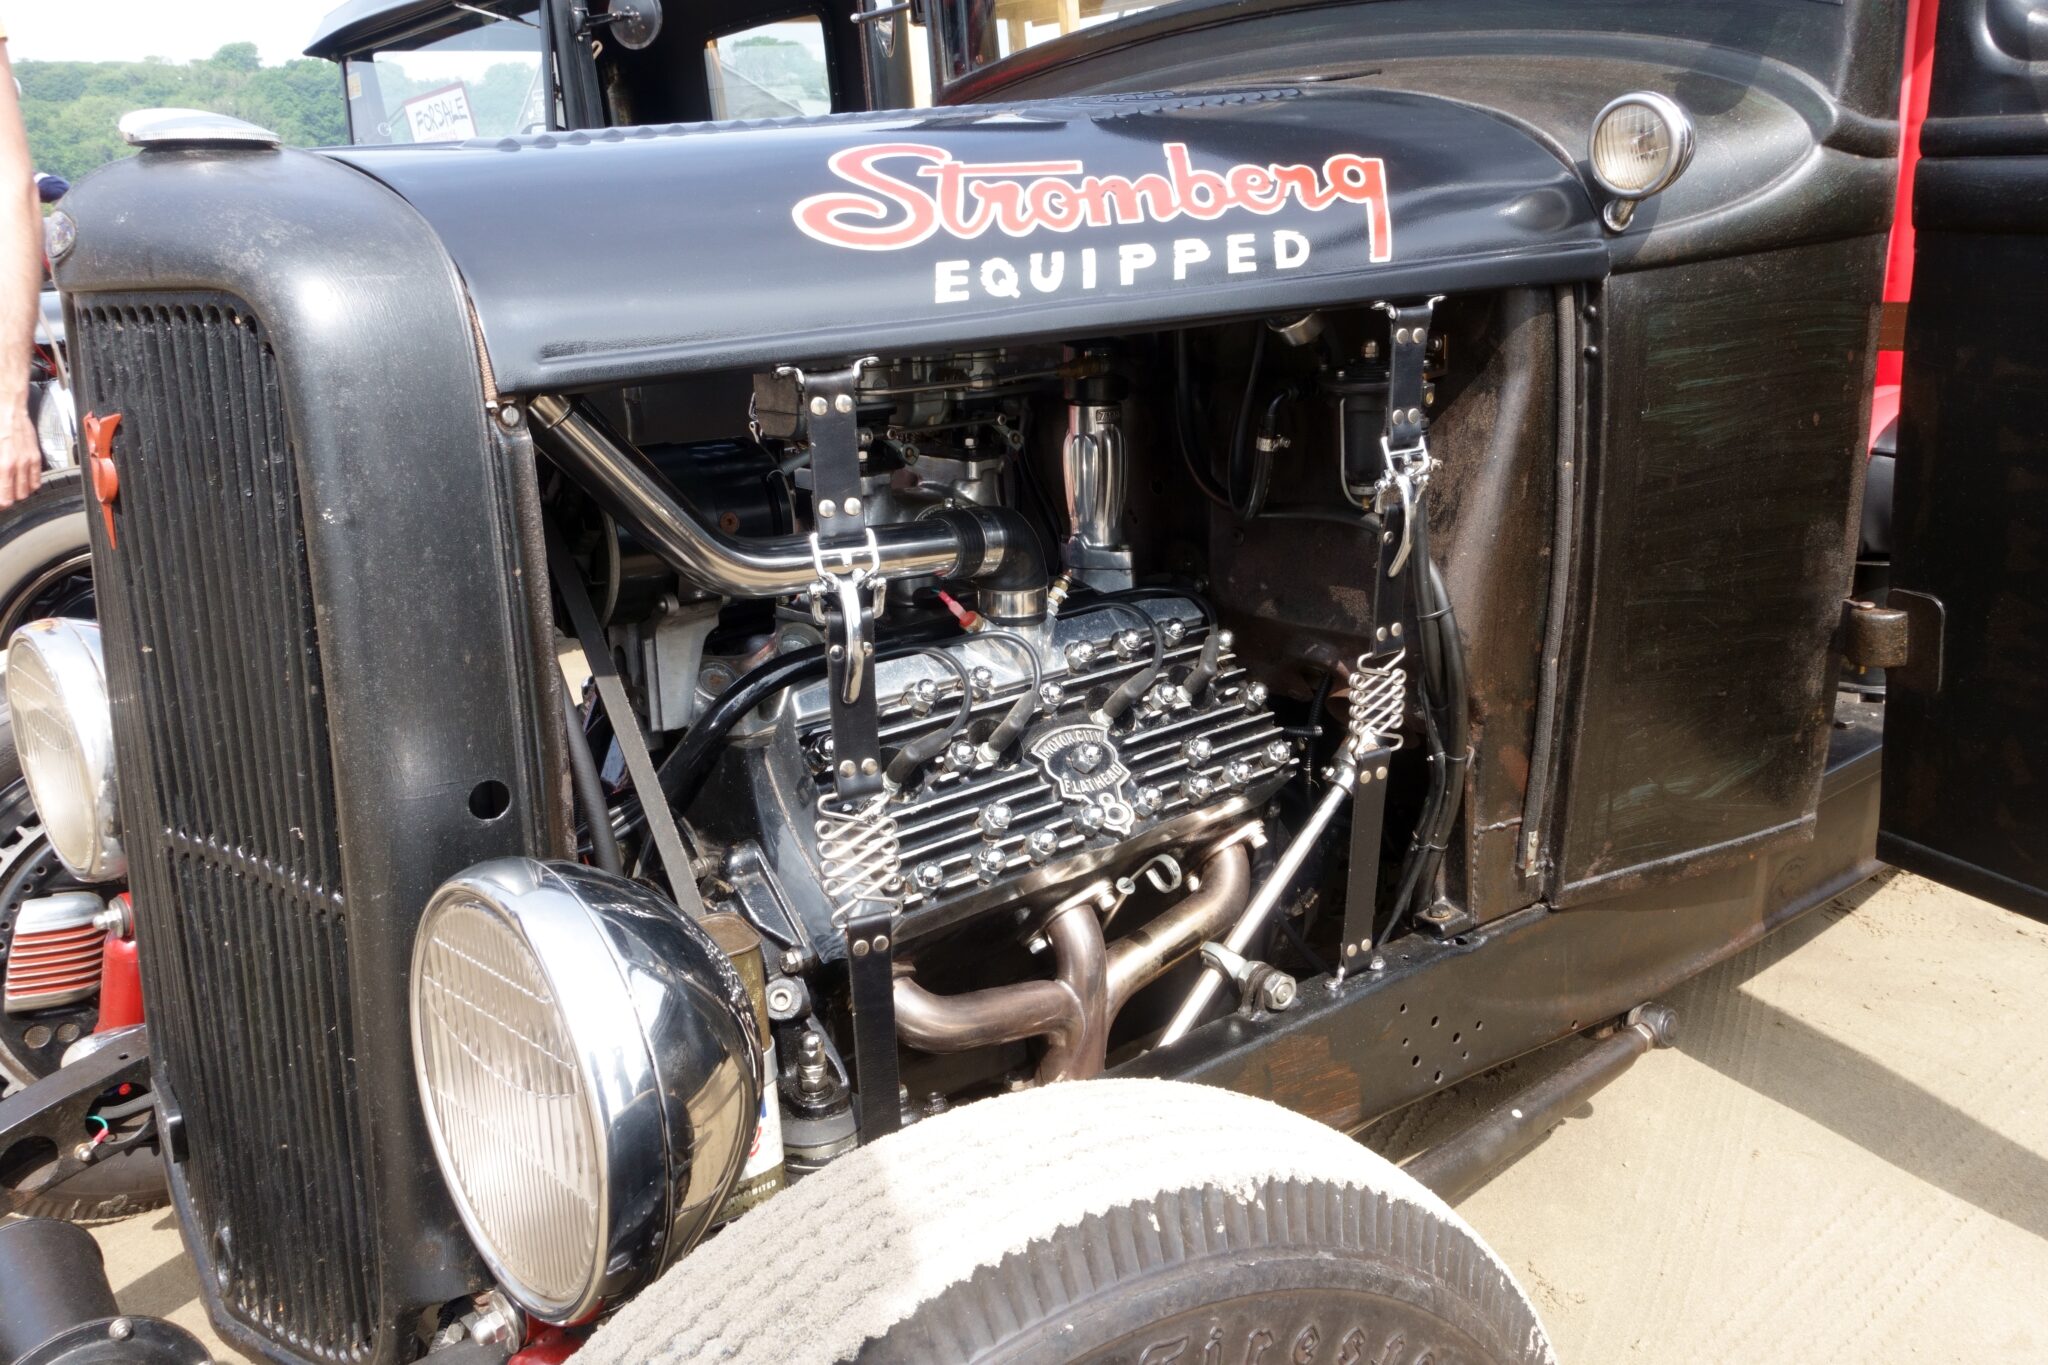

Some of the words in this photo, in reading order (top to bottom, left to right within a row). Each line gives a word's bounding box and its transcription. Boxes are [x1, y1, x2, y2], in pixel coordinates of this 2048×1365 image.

[415, 104, 439, 135] FOR
[434, 97, 468, 128] SALE
[792, 143, 1392, 263] Stromberg
[934, 231, 1311, 304] EQUIPPED
[1040, 731, 1076, 758] MOTOR
[1075, 729, 1104, 743] CITY
[1064, 763, 1123, 793] FLATHEAD
